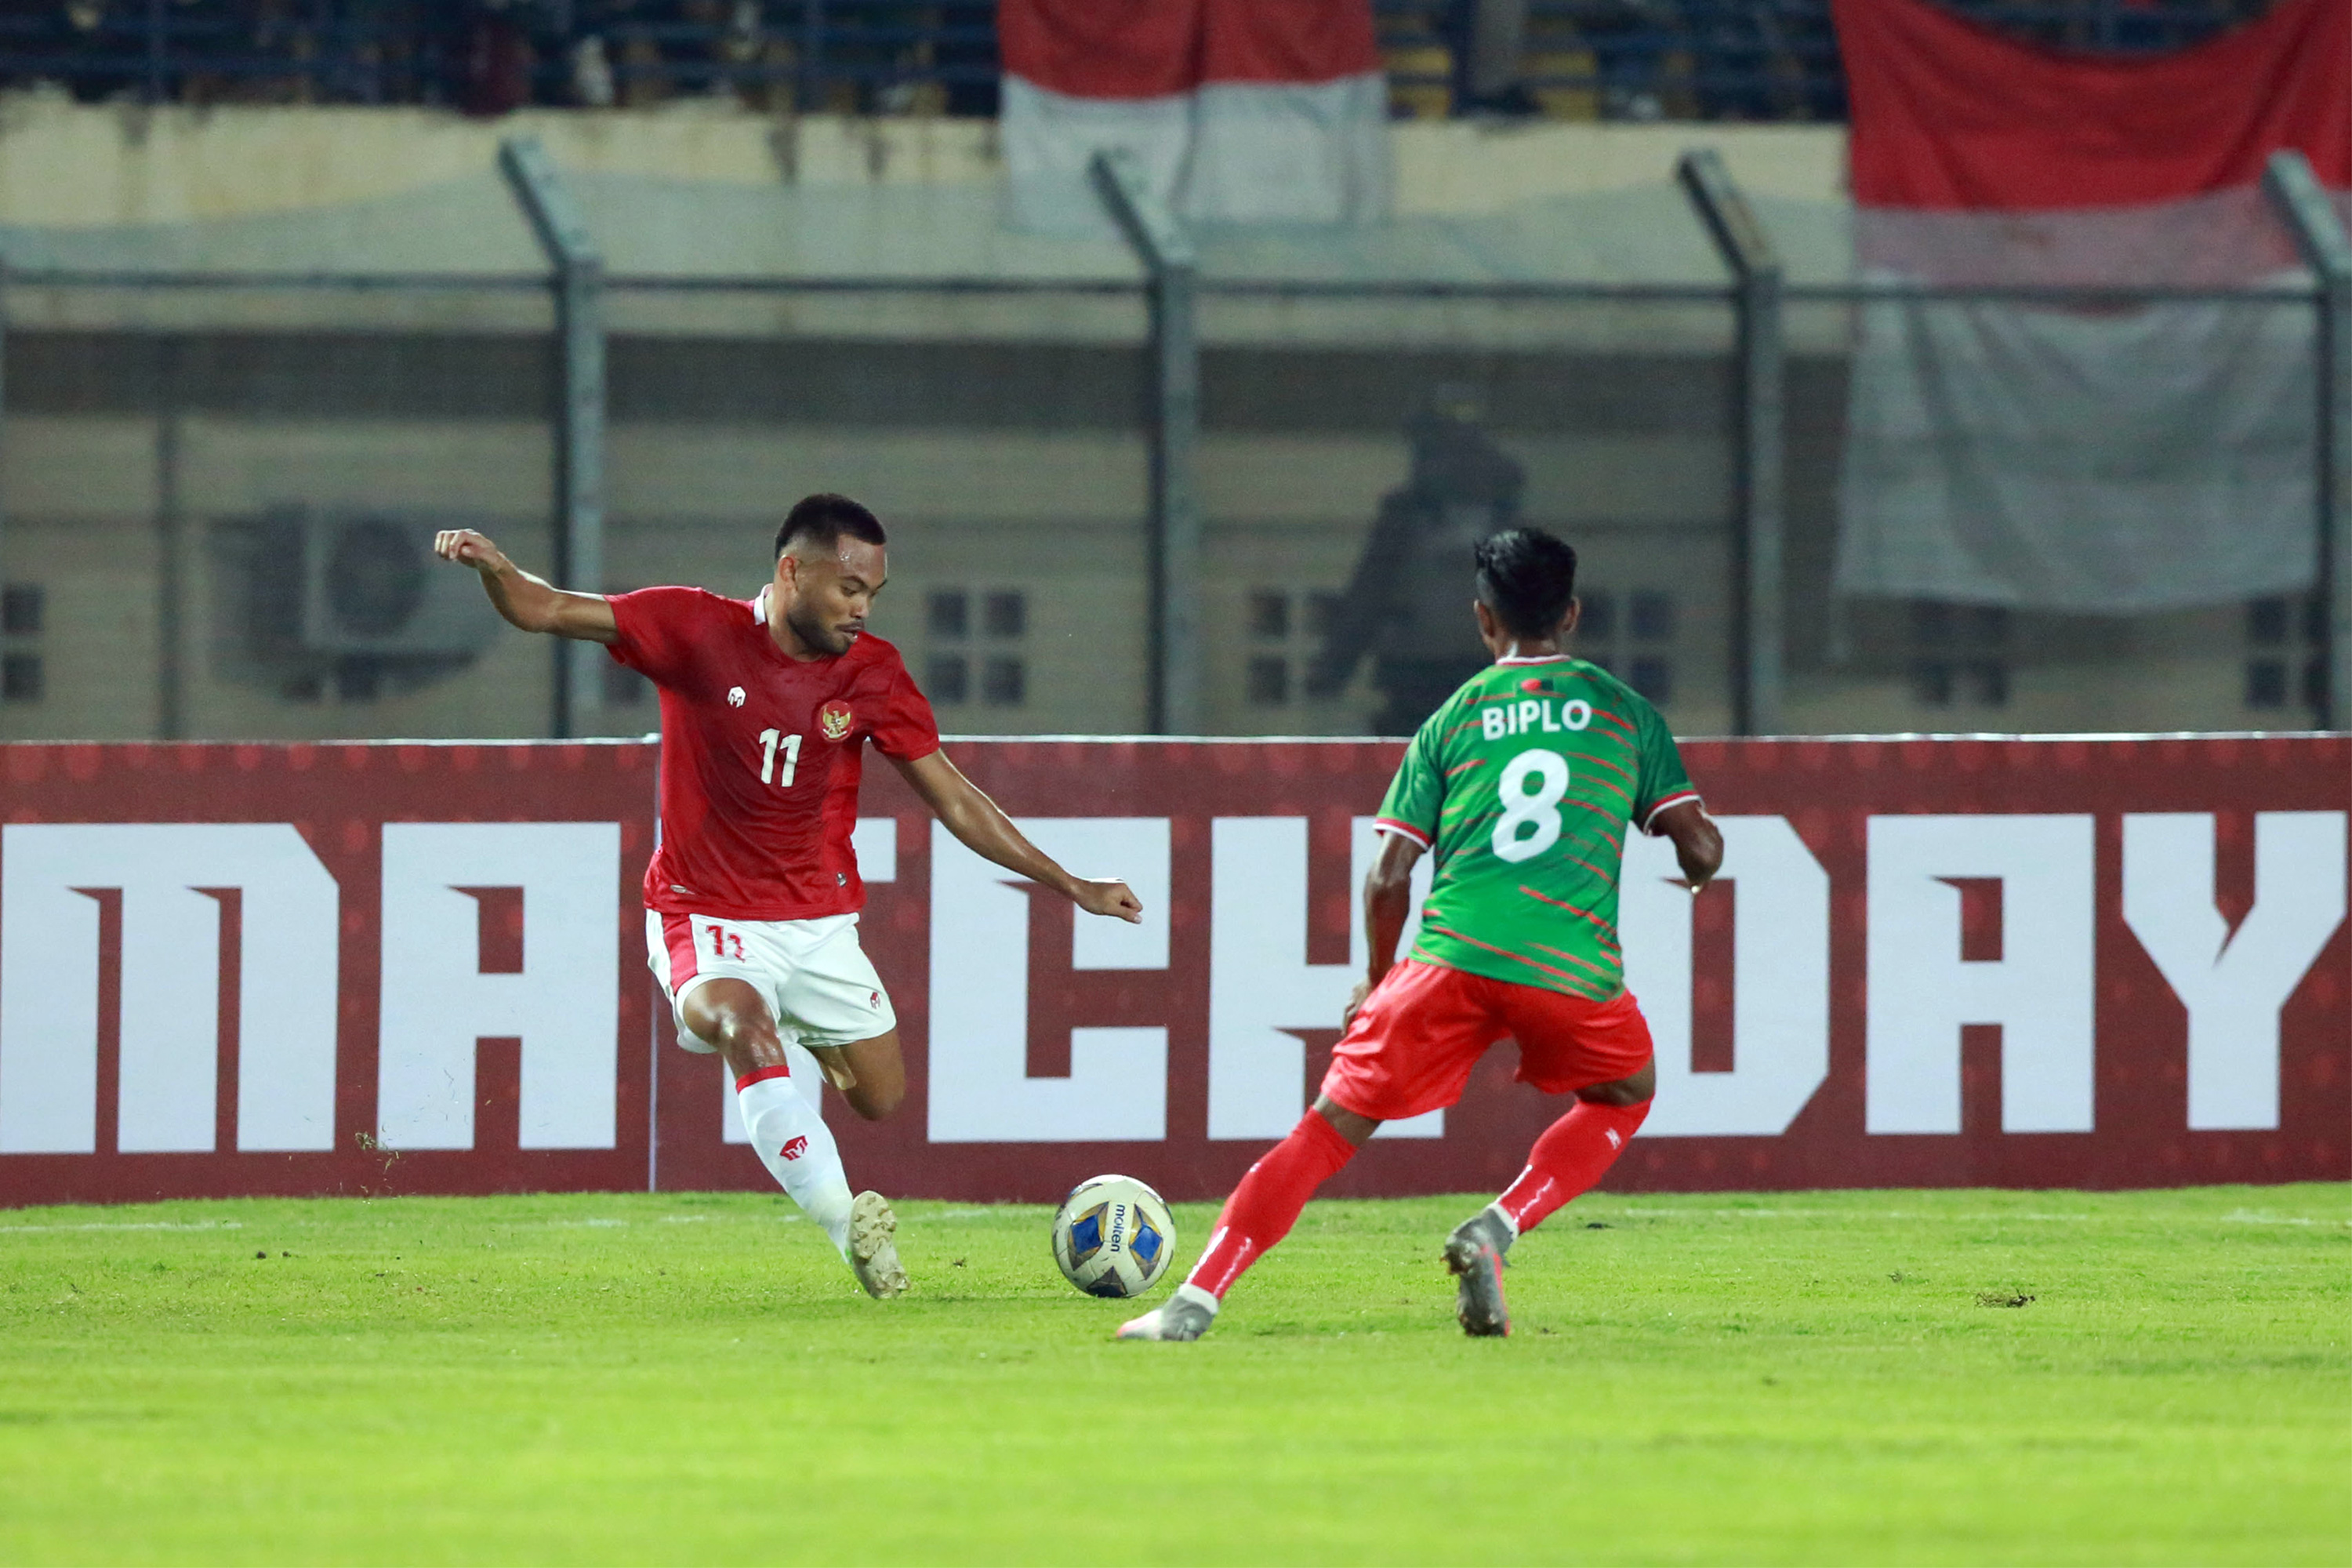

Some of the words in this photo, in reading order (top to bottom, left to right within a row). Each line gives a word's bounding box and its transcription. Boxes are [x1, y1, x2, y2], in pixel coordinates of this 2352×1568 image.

[1482, 699, 1592, 741] BIPLO
[759, 728, 803, 787] 11
[1491, 748, 1570, 863] 8
[0, 816, 1444, 1154] MACH
[1617, 811, 2348, 1136] DAY
[1110, 1204, 1126, 1252] molten
